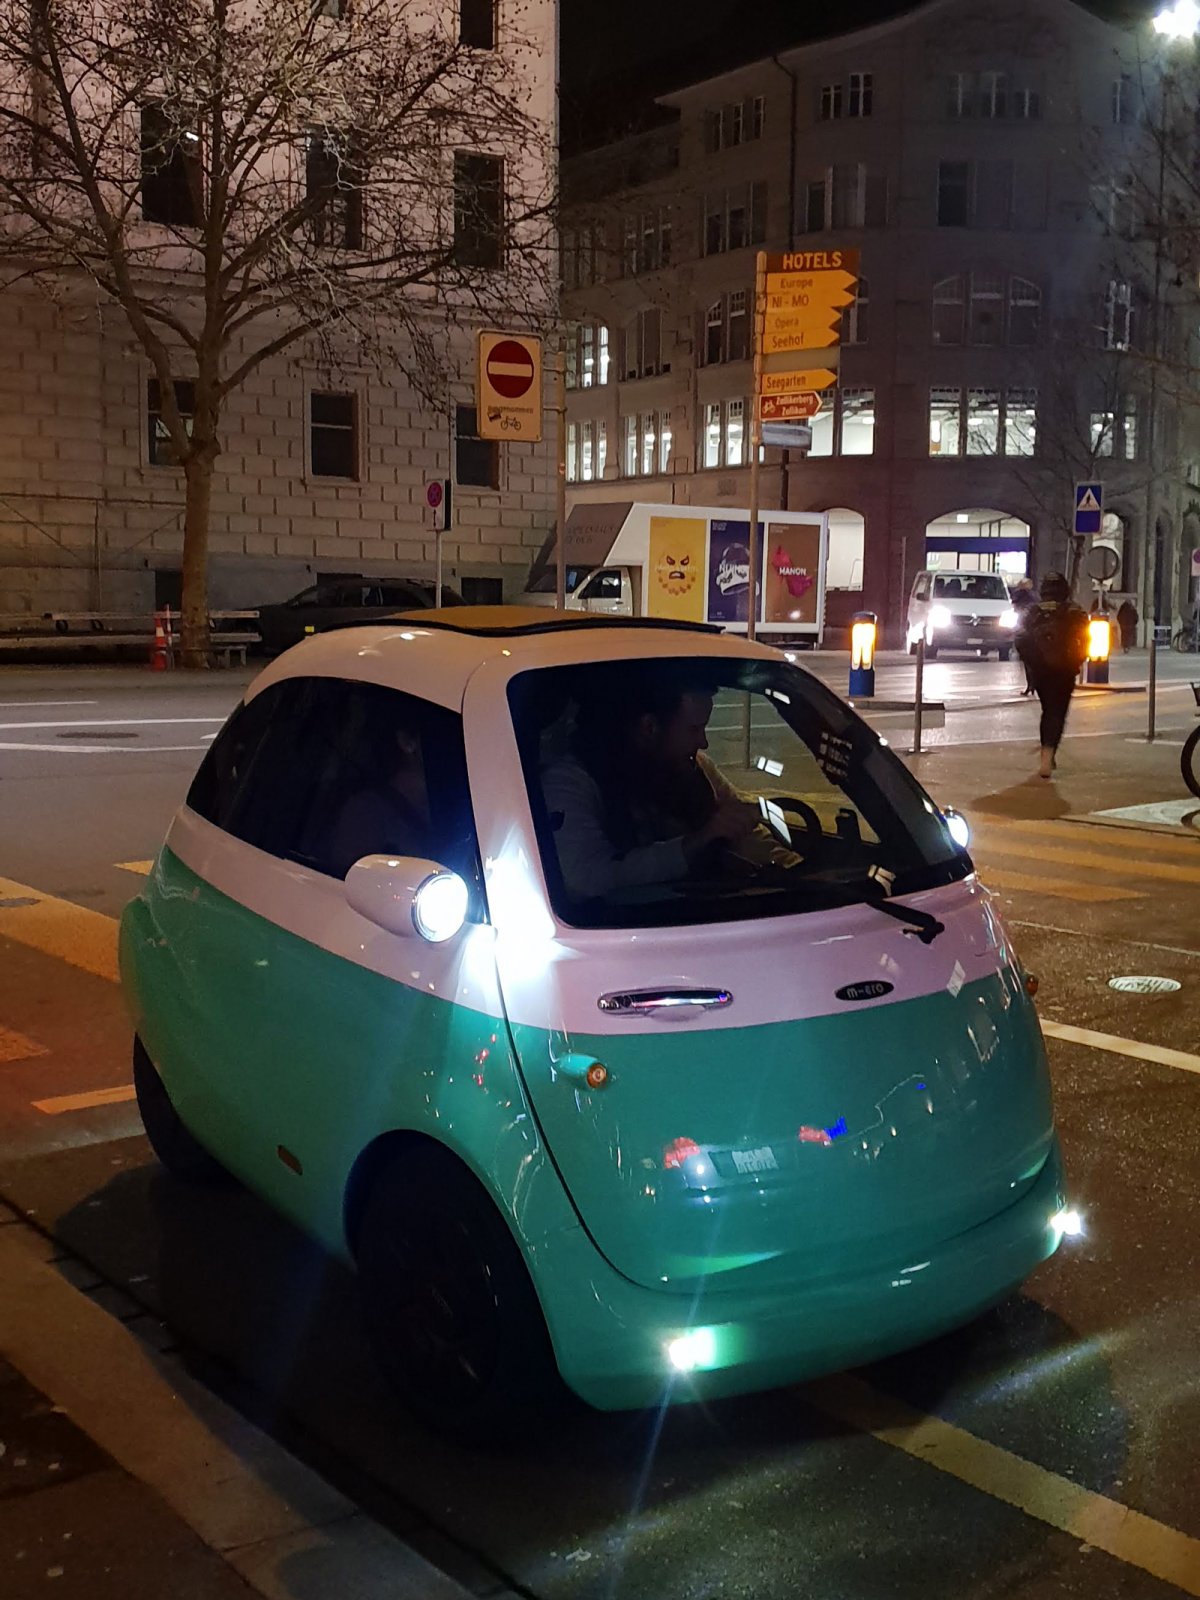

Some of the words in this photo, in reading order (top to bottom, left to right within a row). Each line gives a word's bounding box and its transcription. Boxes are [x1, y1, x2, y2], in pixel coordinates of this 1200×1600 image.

[783, 252, 842, 269] HOTELS
[780, 277, 813, 290] Europe
[791, 294, 809, 307] MO
[774, 318, 799, 330] Opera
[772, 333, 804, 348] Seehof
[766, 375, 806, 391] Seegarten
[779, 567, 807, 576] MANON
